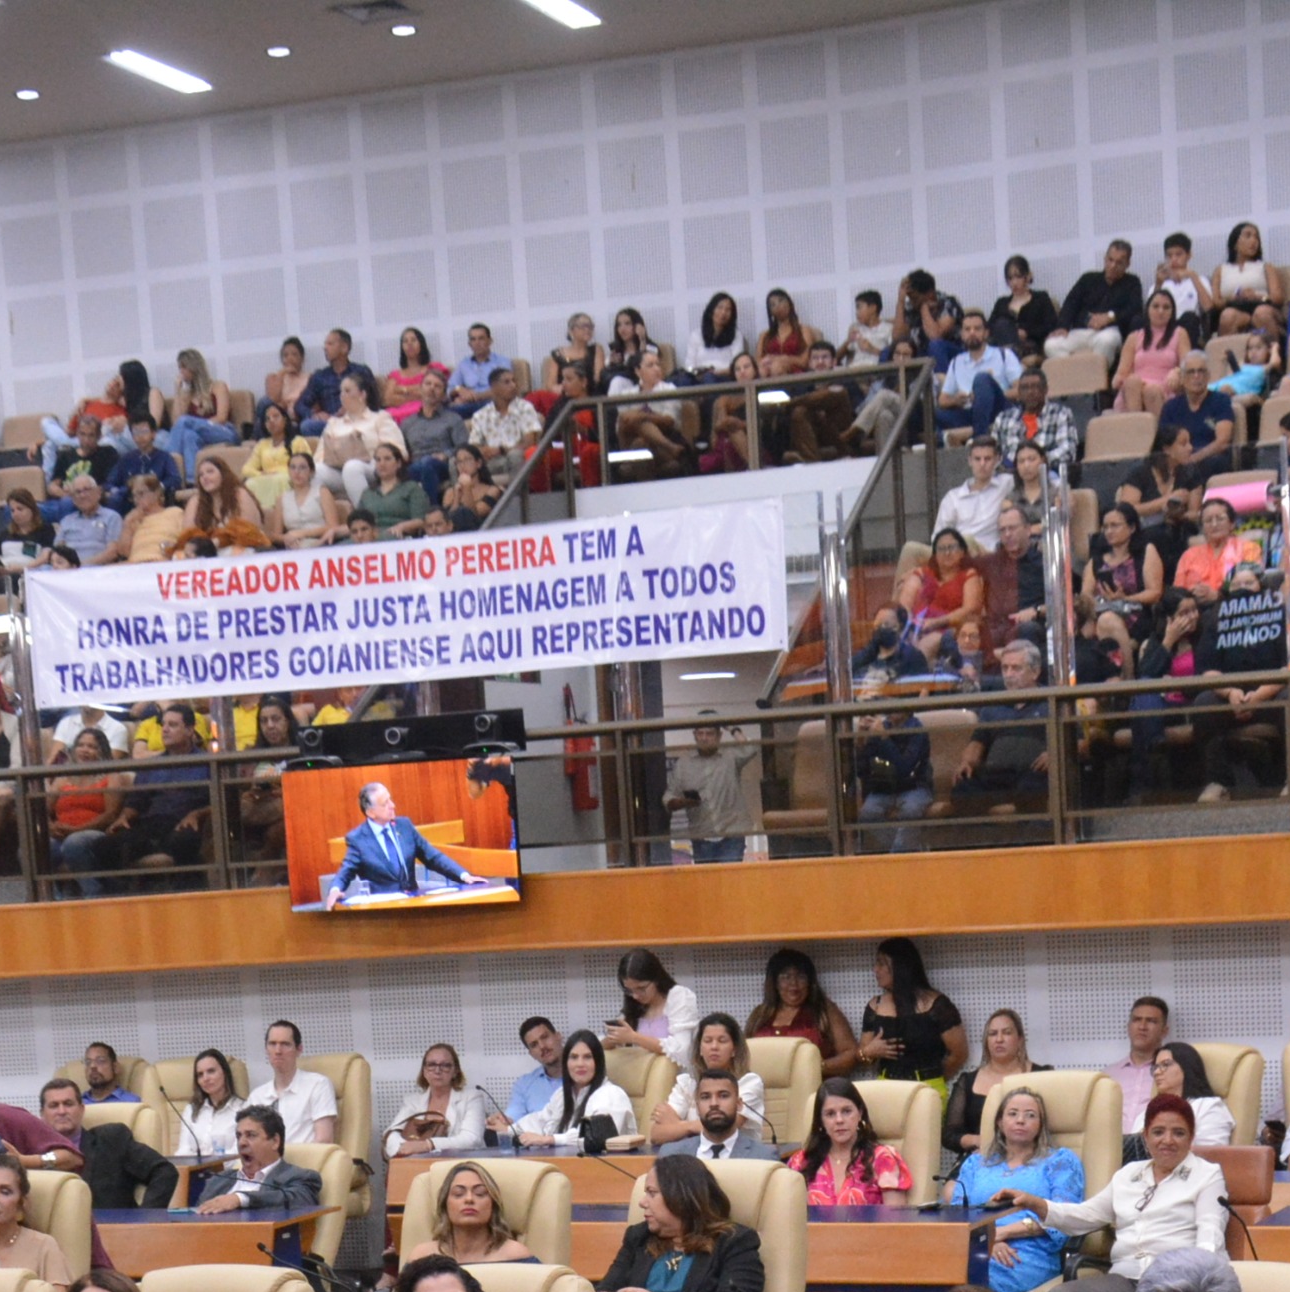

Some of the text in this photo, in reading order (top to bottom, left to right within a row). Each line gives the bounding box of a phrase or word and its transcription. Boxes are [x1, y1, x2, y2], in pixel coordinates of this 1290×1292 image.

[79, 561, 736, 649] HONRA DE PRESTAR JUSTA HOMENAGEM A TODOS
[157, 525, 646, 599] VEREADOR ANSELMO PEREIRA TEM A
[55, 605, 766, 692] TRABALHADORES GOIANIENSE AQUI REPRESENTANDO
